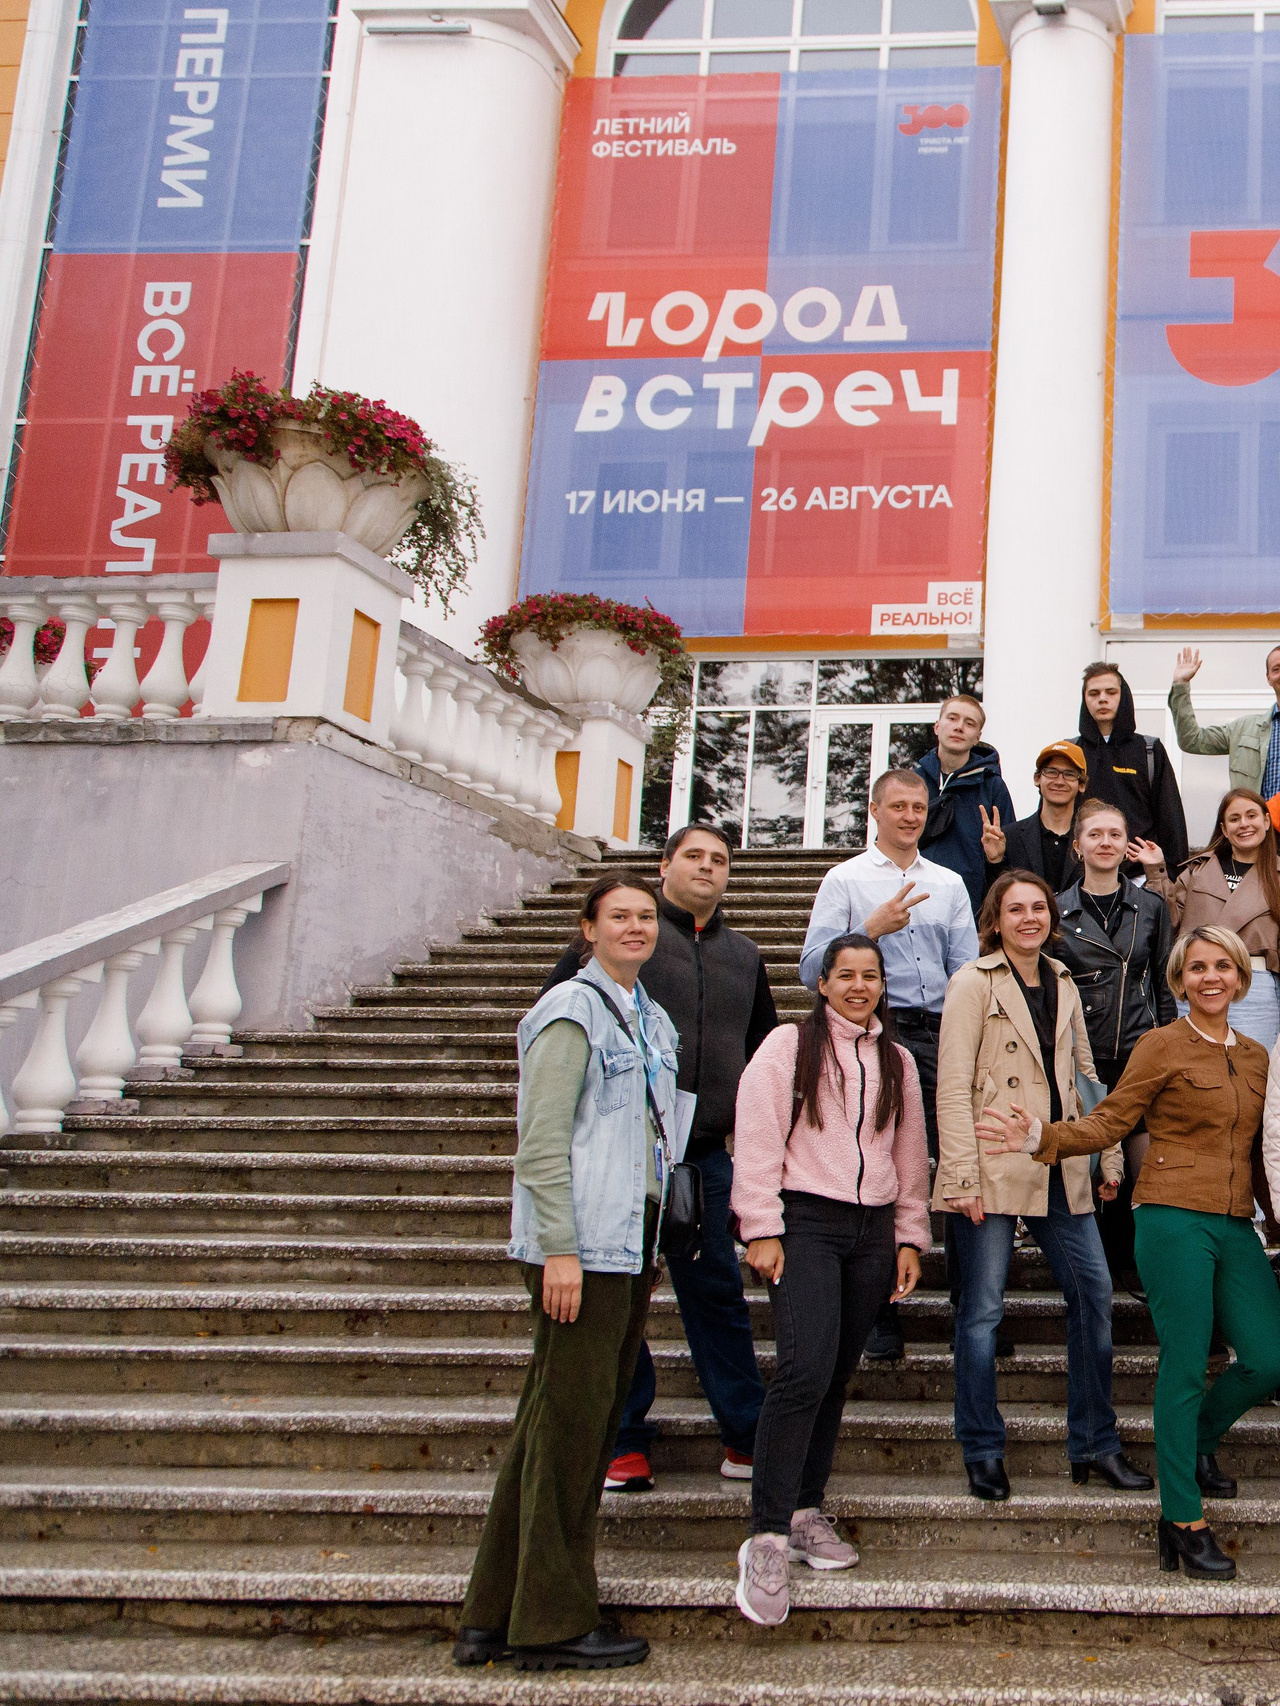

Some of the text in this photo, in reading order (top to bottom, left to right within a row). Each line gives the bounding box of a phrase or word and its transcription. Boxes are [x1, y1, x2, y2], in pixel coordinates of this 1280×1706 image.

[158, 8, 229, 208] ПЕРМИ
[592, 112, 691, 135] ЛЕТНИЙ
[591, 138, 737, 158] ФЕСТИВАЛЬ
[130, 282, 196, 396] ВСЁ
[565, 490, 594, 514] 17
[602, 488, 706, 513] ИЮНЯ
[760, 487, 797, 512] 26
[804, 484, 954, 510] АВГУСТА
[937, 587, 974, 606] ВСЁ
[879, 611, 973, 627] РЕАЛЬНО!
